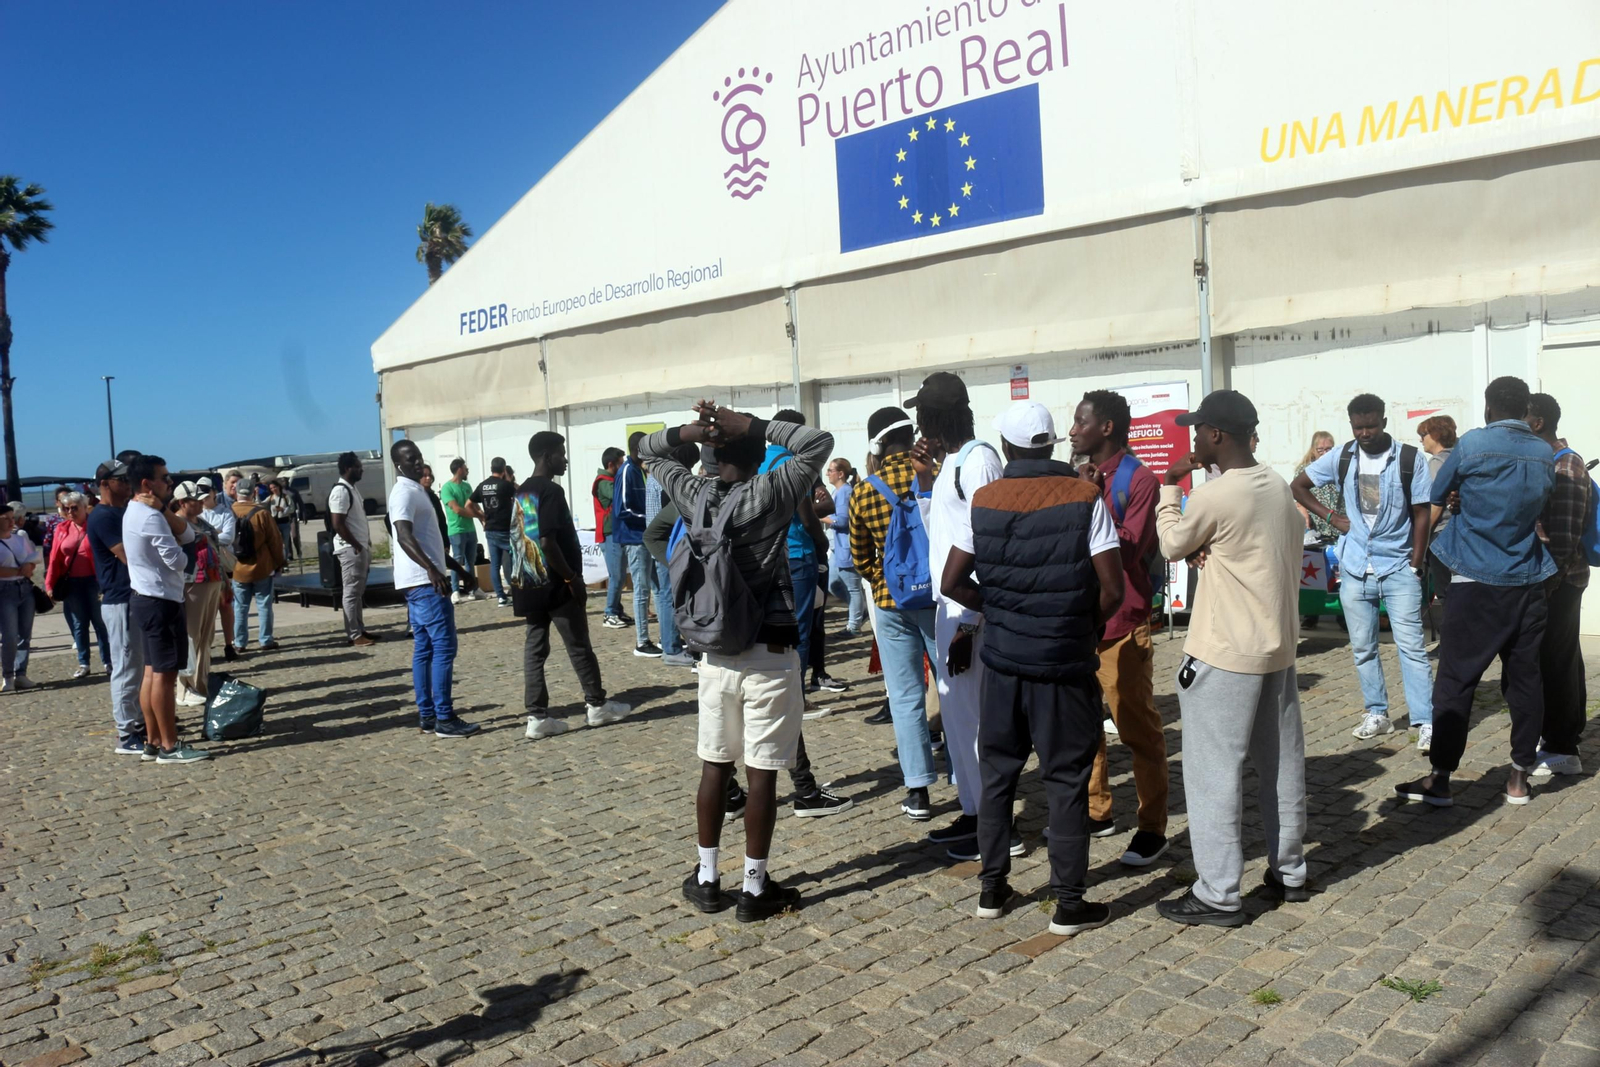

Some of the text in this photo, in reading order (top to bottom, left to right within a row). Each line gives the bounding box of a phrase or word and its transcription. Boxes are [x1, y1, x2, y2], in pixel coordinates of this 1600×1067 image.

[797, 0, 1008, 91] Ayuntamiento
[797, 3, 1069, 147] Puerto Real
[1260, 111, 1347, 163] UNA
[1357, 67, 1564, 146] MANERA
[460, 257, 723, 335] FEDER Fondo Europeo de Desarrollo Regional
[1128, 429, 1163, 438] REFUGIO
